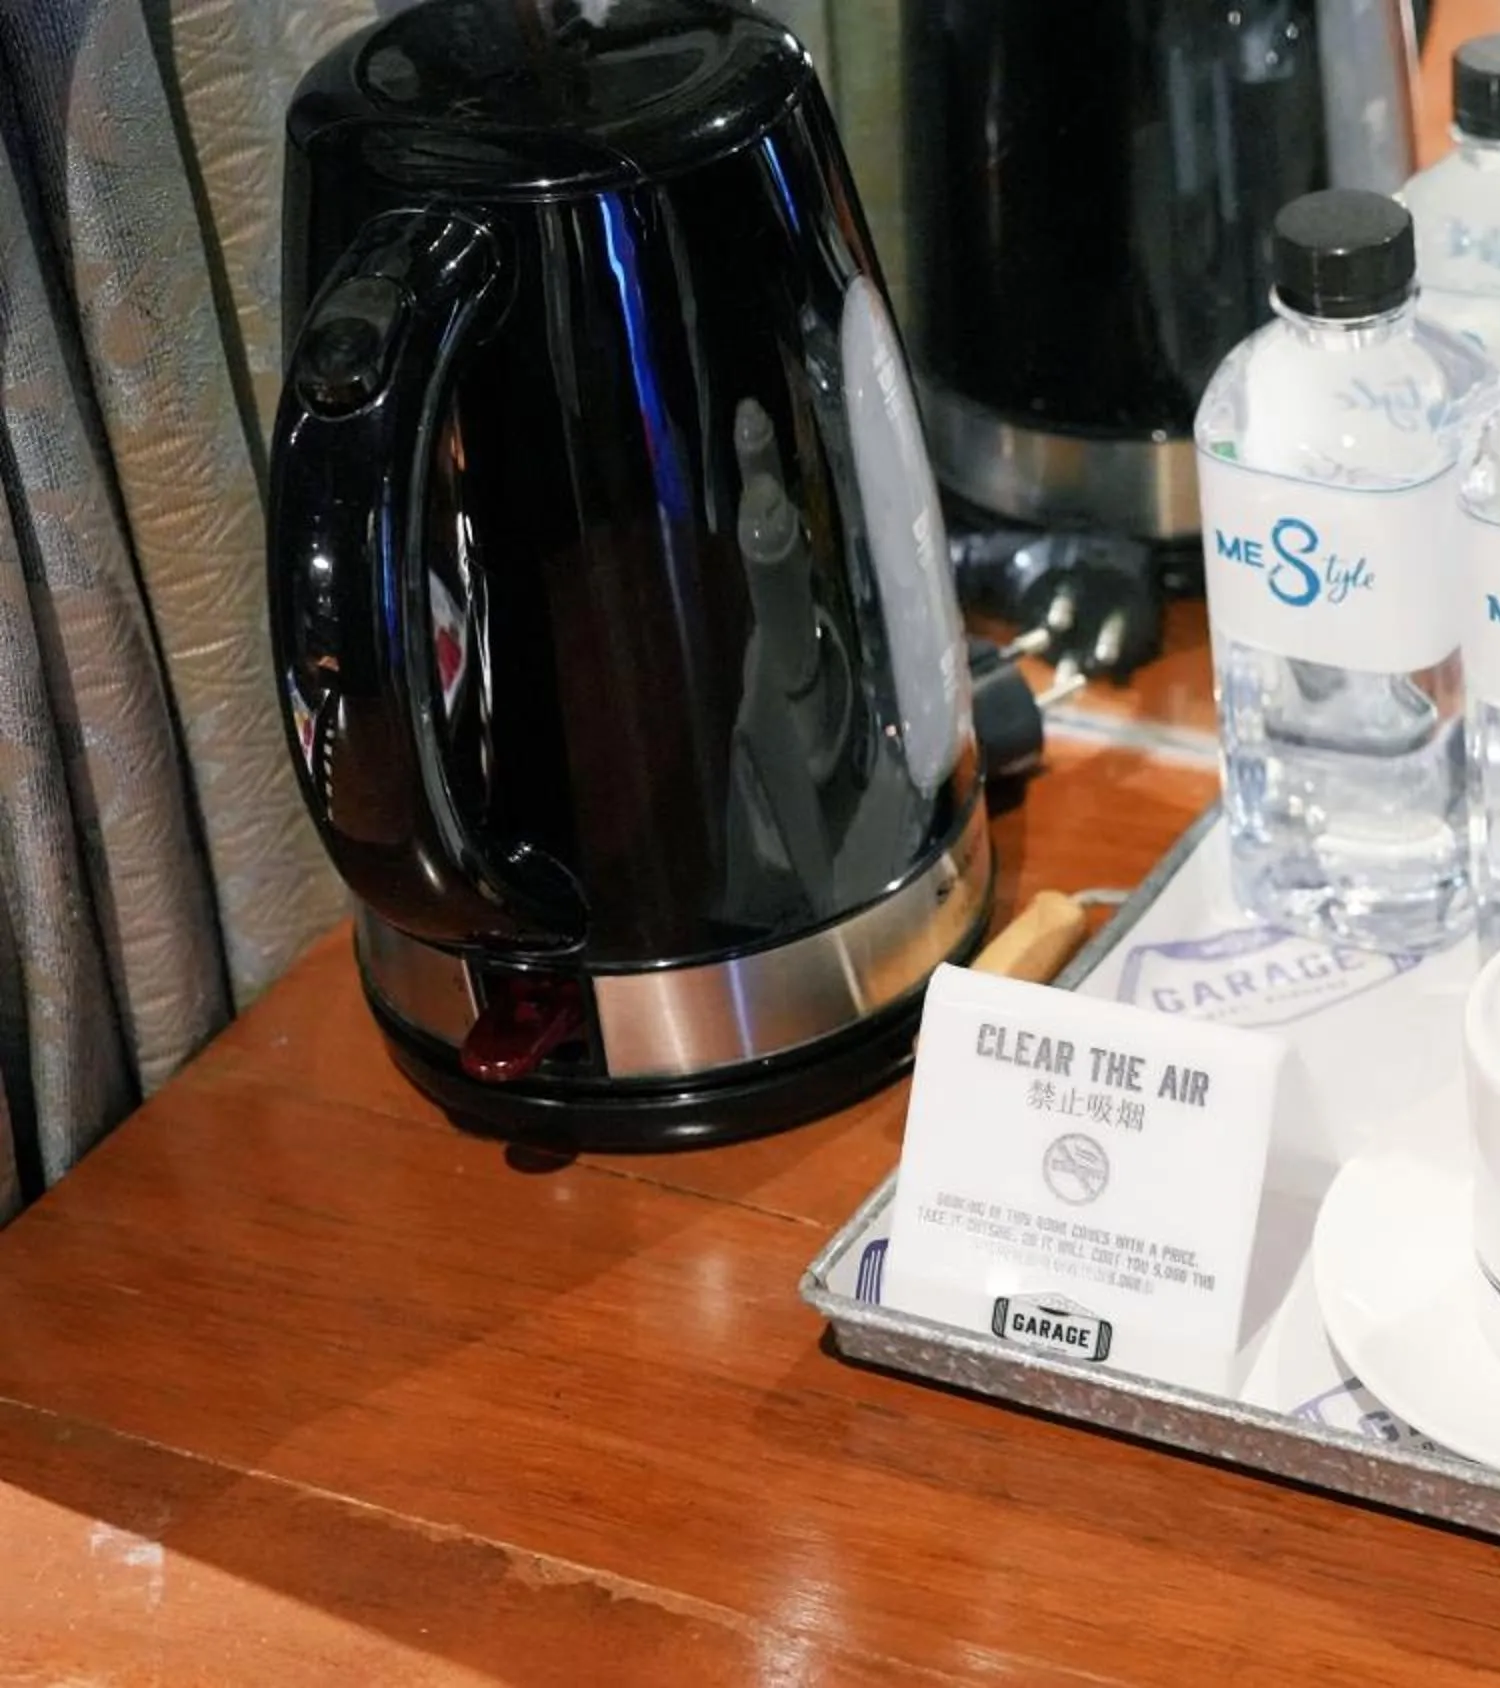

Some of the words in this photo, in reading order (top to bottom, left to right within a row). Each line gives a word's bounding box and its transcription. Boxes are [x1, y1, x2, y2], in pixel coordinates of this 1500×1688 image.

[976, 1022, 1075, 1077] CLEAR
[1089, 1047, 1146, 1093] THE
[1157, 1064, 1210, 1107] AIR
[1026, 1078, 1146, 1133] 禁止吸烟
[1012, 1312, 1091, 1349] GARAGE
